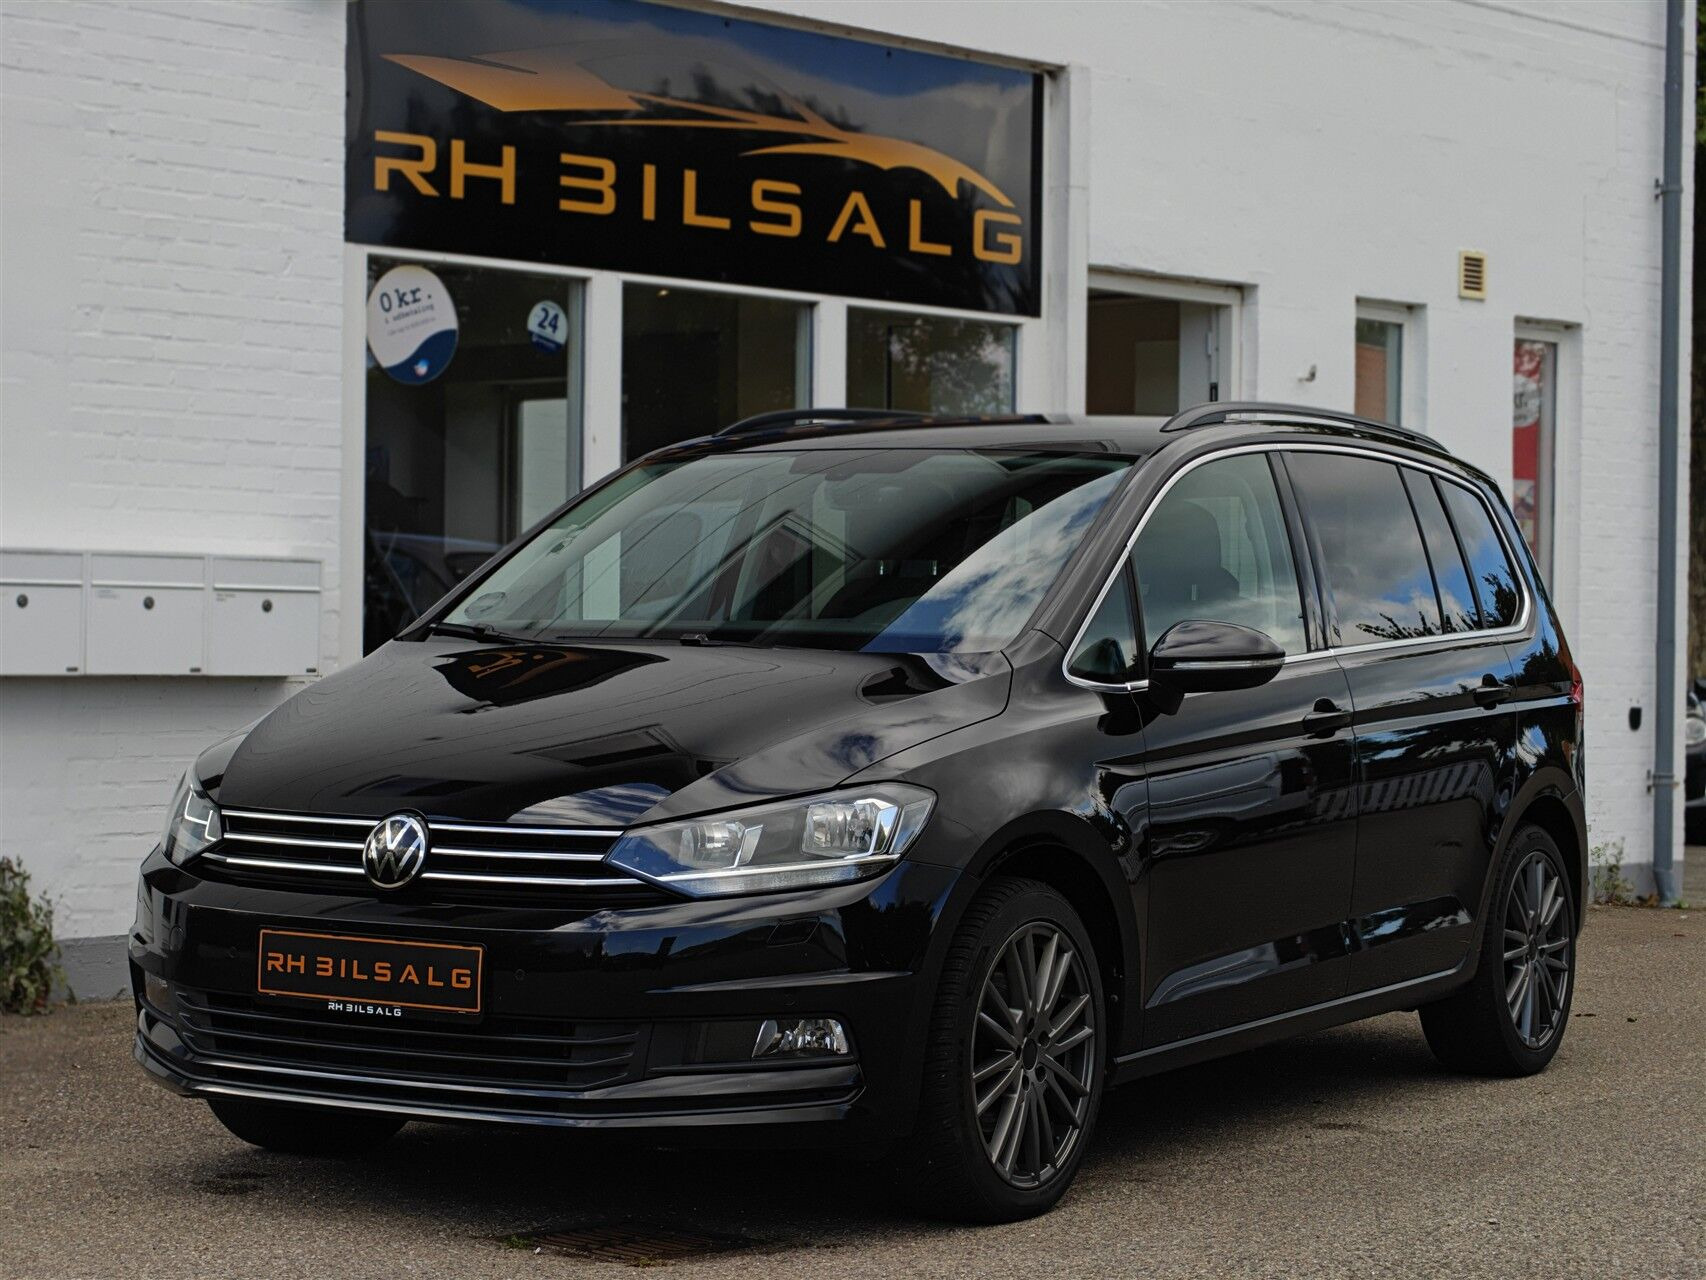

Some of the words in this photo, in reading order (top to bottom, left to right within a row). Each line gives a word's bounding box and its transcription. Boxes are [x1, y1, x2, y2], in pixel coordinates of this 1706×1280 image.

[375, 130, 516, 205] RH
[559, 153, 1022, 265] BILSALG
[394, 287, 432, 308] kr.
[537, 307, 559, 334] 24
[267, 952, 305, 974] RH
[316, 956, 471, 989] BILSALG
[328, 1002, 343, 1011] RH
